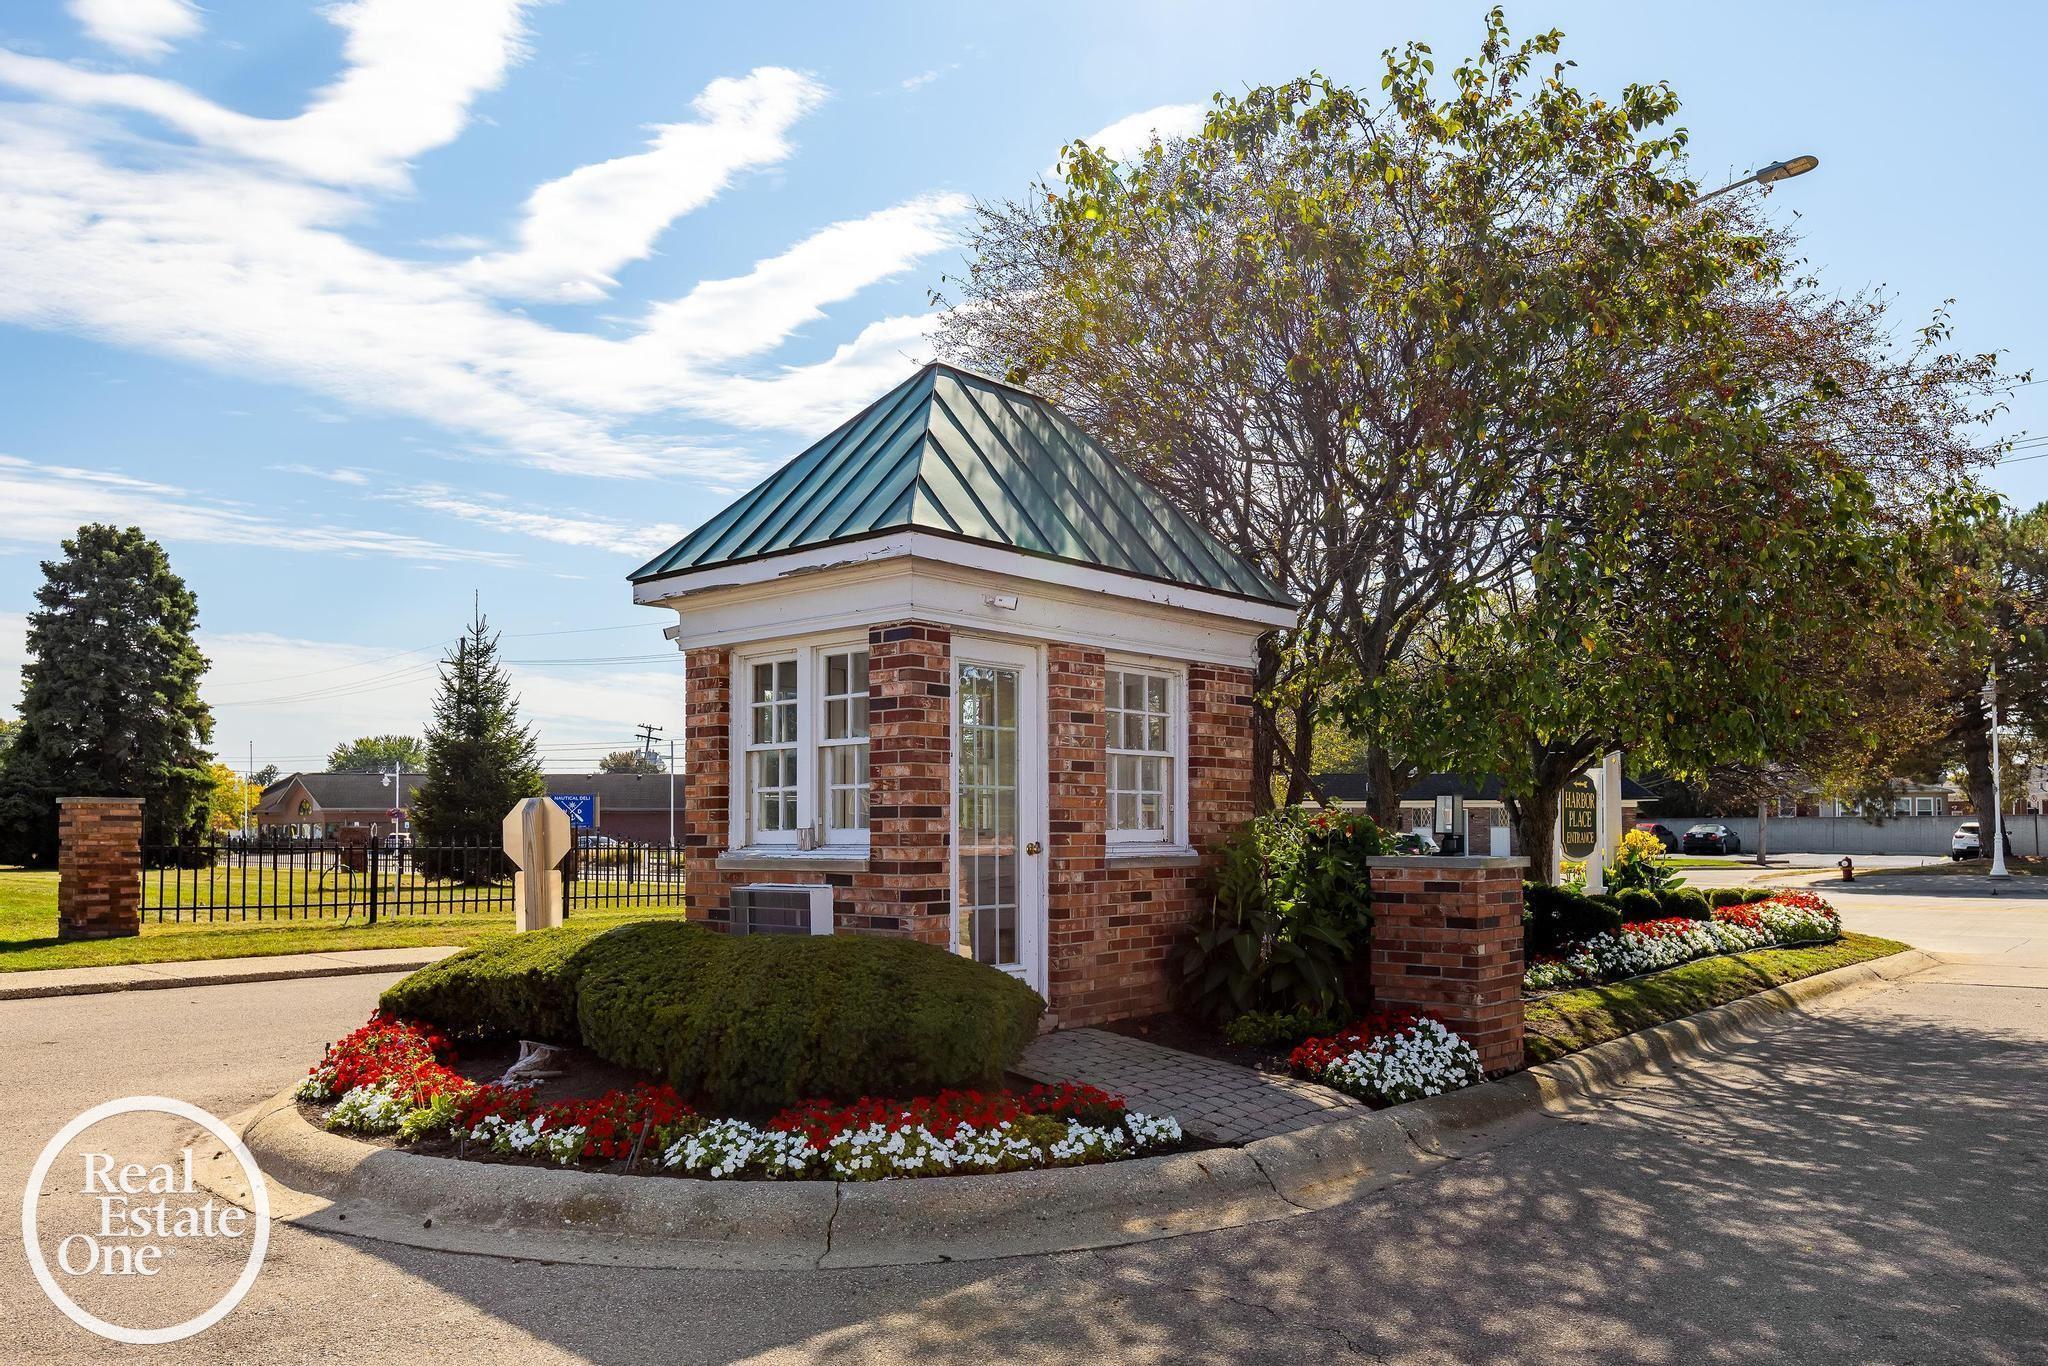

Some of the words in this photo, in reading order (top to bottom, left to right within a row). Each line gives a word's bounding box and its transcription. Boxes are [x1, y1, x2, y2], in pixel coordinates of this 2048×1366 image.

[1565, 791, 1595, 809] HARBOR
[1569, 811, 1592, 828] PLACE
[1566, 831, 1594, 844] ENTRANCE
